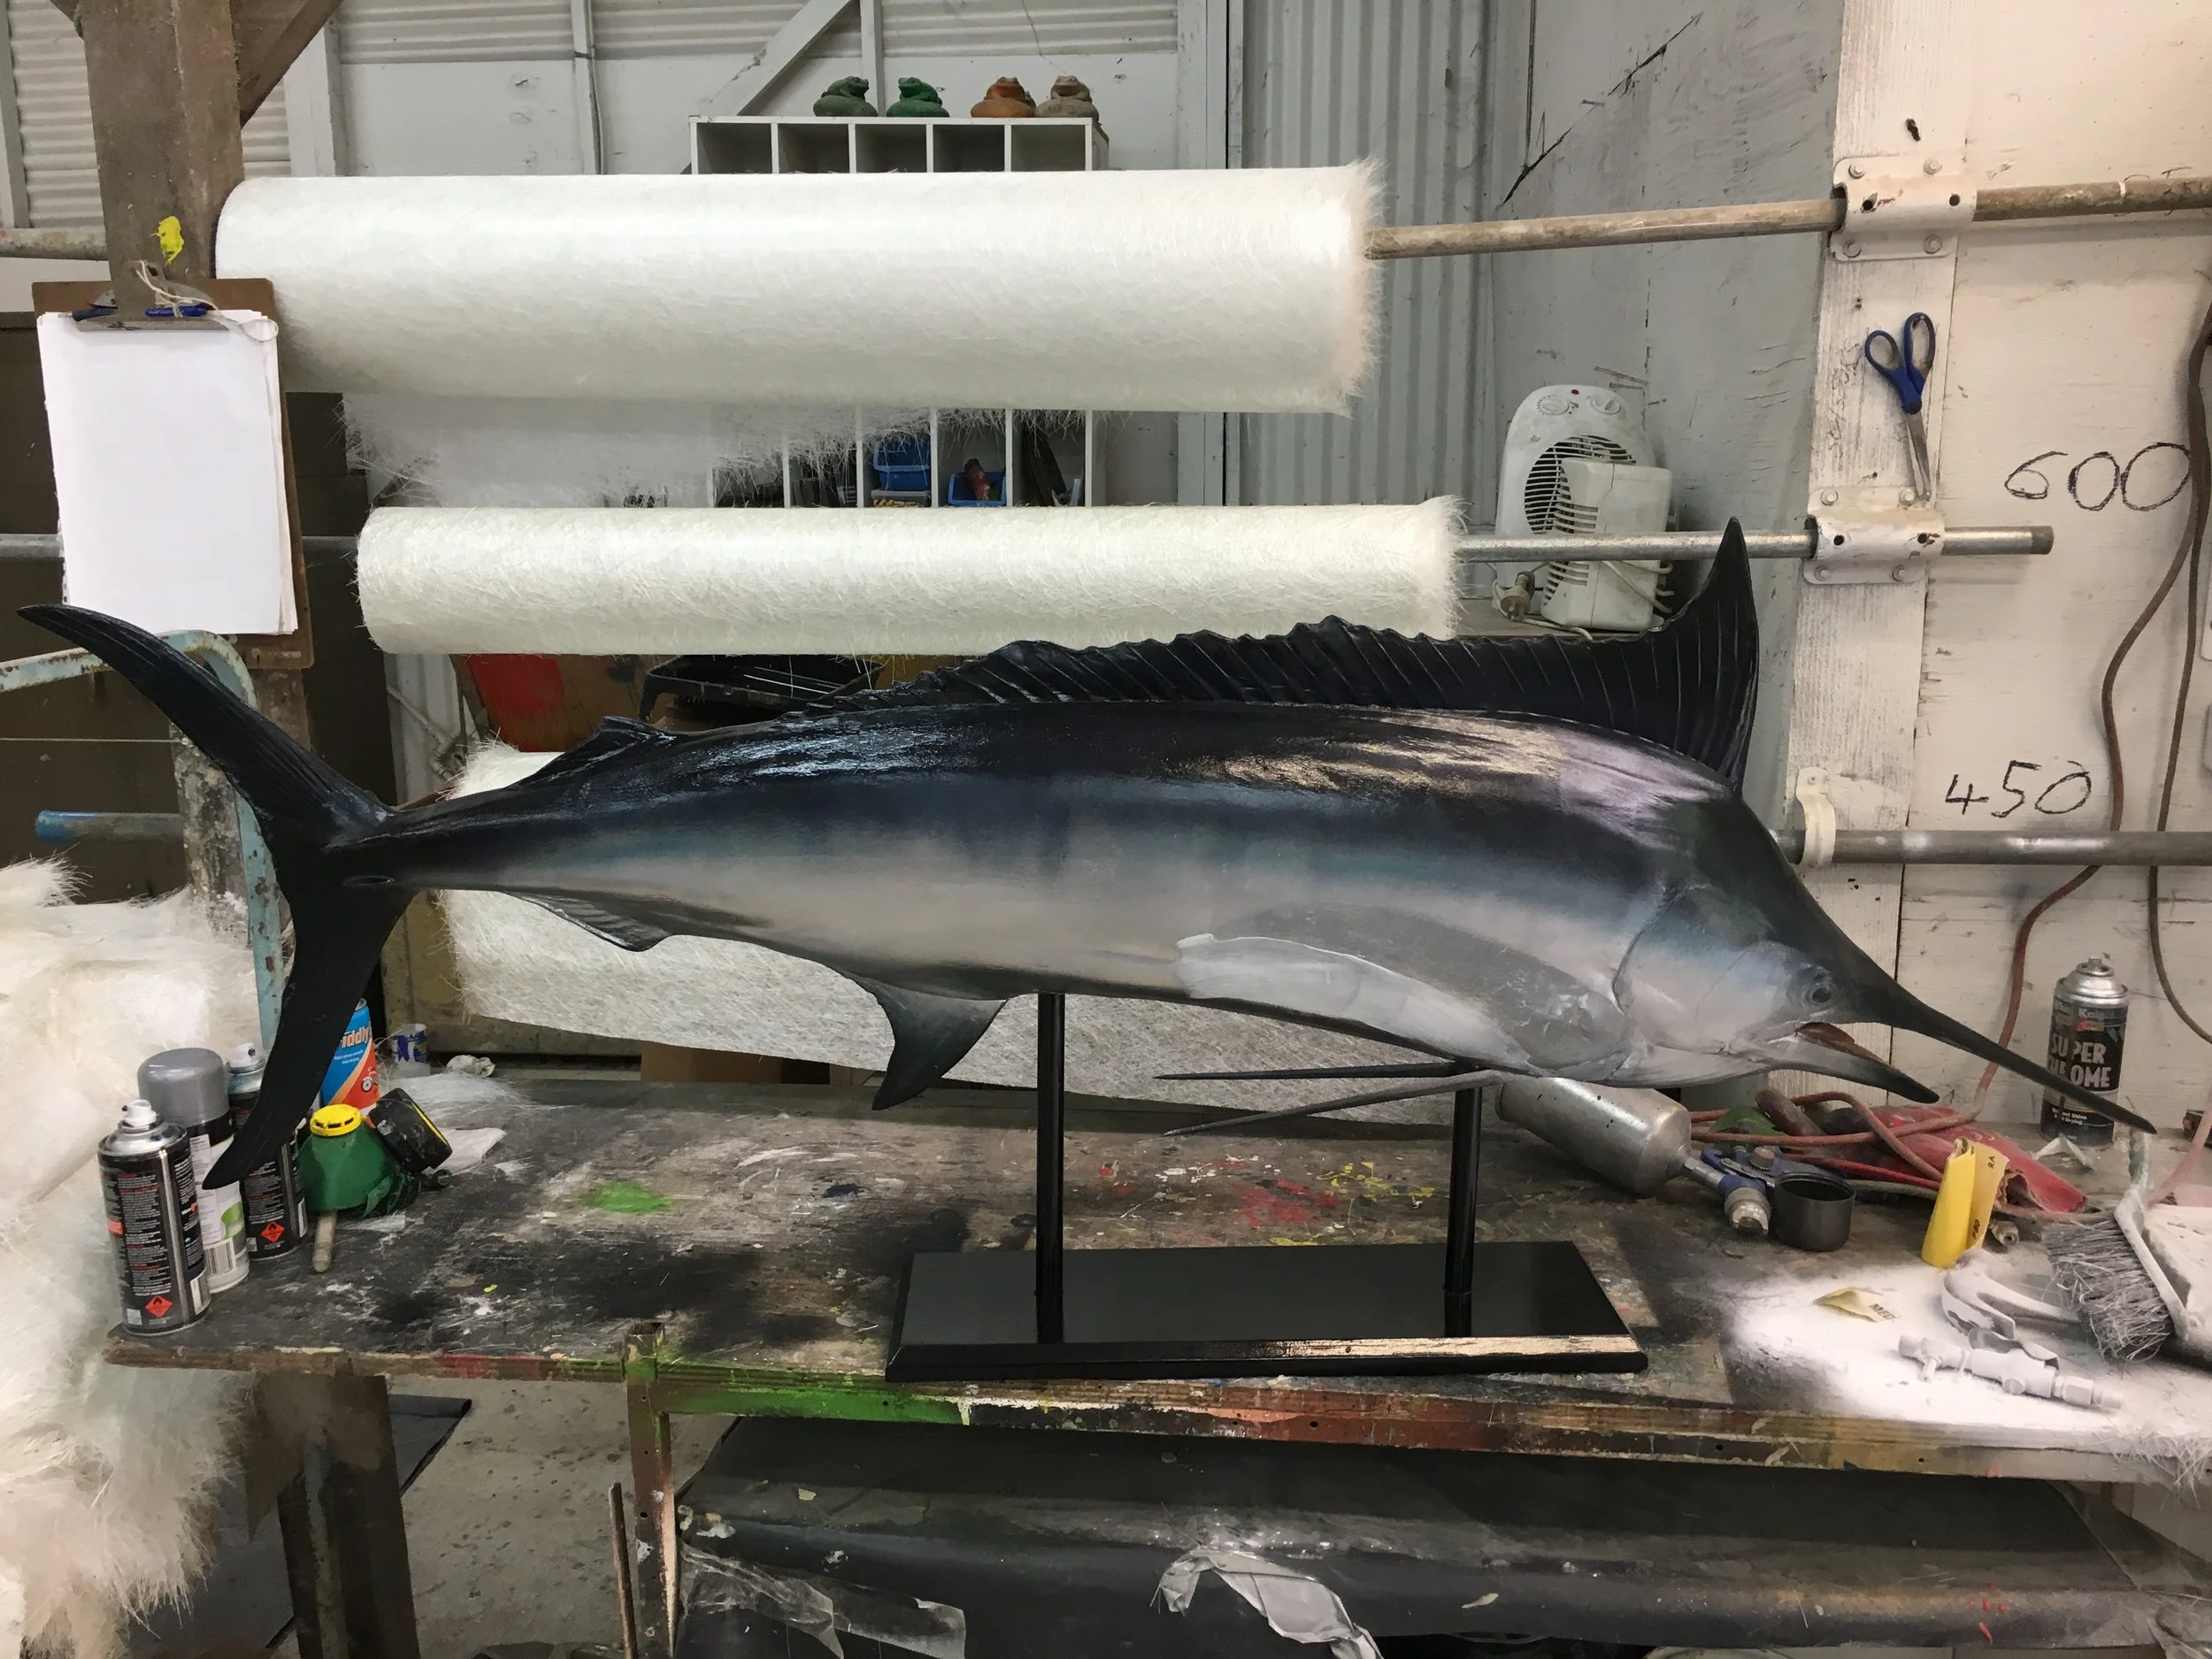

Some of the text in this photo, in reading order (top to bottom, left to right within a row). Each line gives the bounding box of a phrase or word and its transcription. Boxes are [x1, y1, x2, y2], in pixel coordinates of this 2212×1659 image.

[2003, 442, 2192, 511] 600
[1945, 759, 2093, 818] 450
[2051, 1033, 2107, 1064] SUPER
[1868, 1302, 1897, 1321] MED
